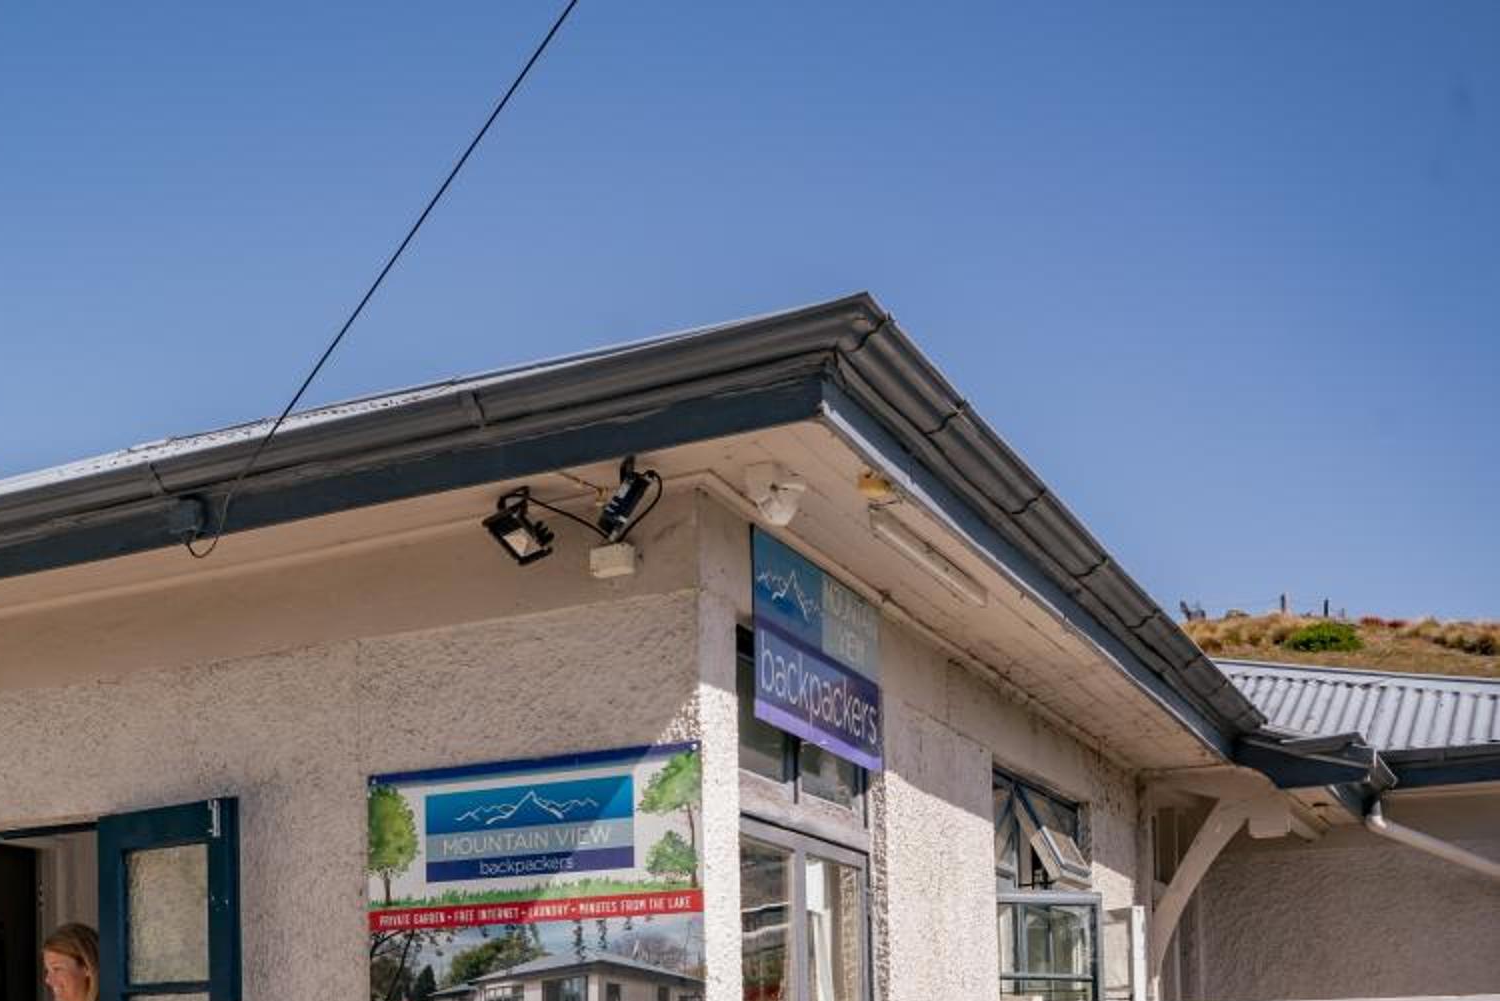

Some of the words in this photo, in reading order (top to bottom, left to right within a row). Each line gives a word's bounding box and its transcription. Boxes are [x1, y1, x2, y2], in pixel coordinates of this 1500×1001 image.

[760, 629, 878, 745] backpackers
[443, 831, 549, 857] MOUNTAIN
[555, 826, 612, 846] VIEW
[478, 854, 574, 876] backpackers
[579, 901, 618, 914] MINUTES
[620, 899, 645, 912] FROM
[649, 897, 664, 910] THE
[668, 896, 691, 909] LAKE
